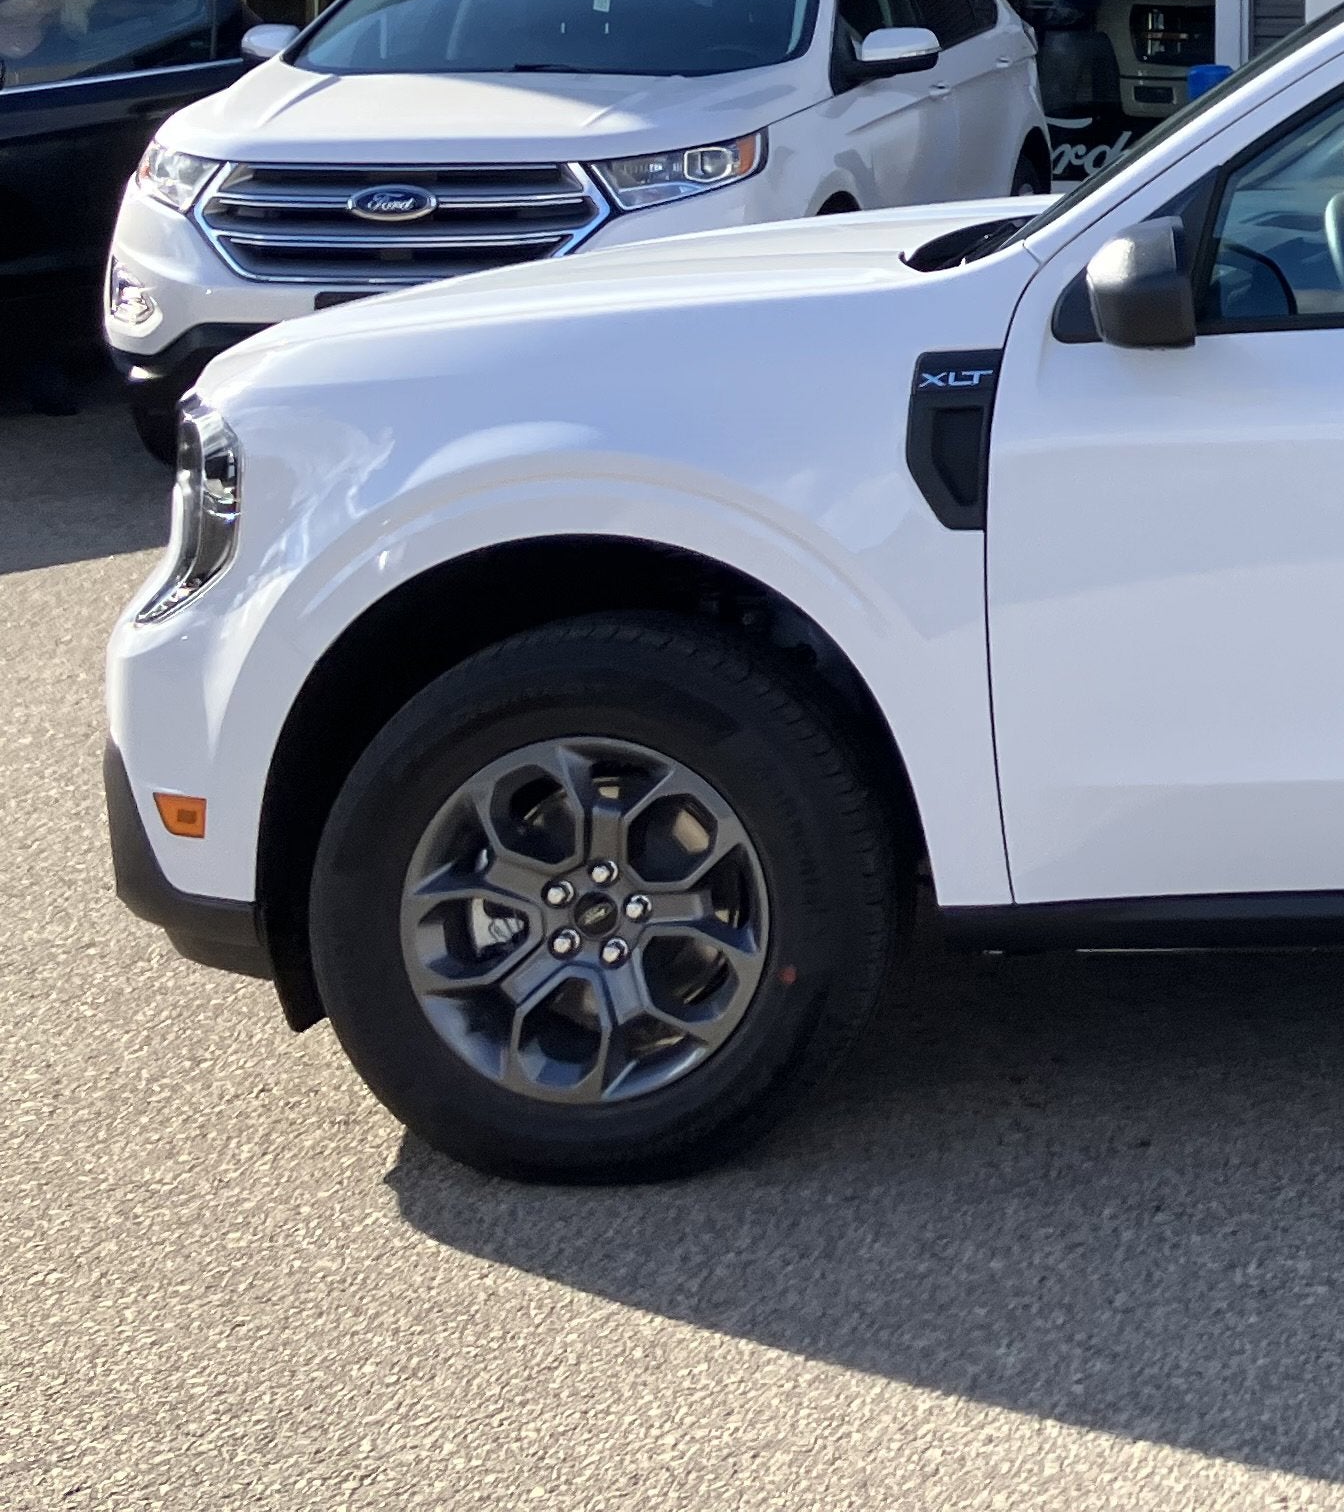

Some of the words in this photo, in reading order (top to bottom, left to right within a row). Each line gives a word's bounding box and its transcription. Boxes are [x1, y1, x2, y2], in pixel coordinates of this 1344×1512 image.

[1045, 116, 1132, 177] rd
[367, 192, 416, 211] Ford
[919, 369, 993, 388] XLT
